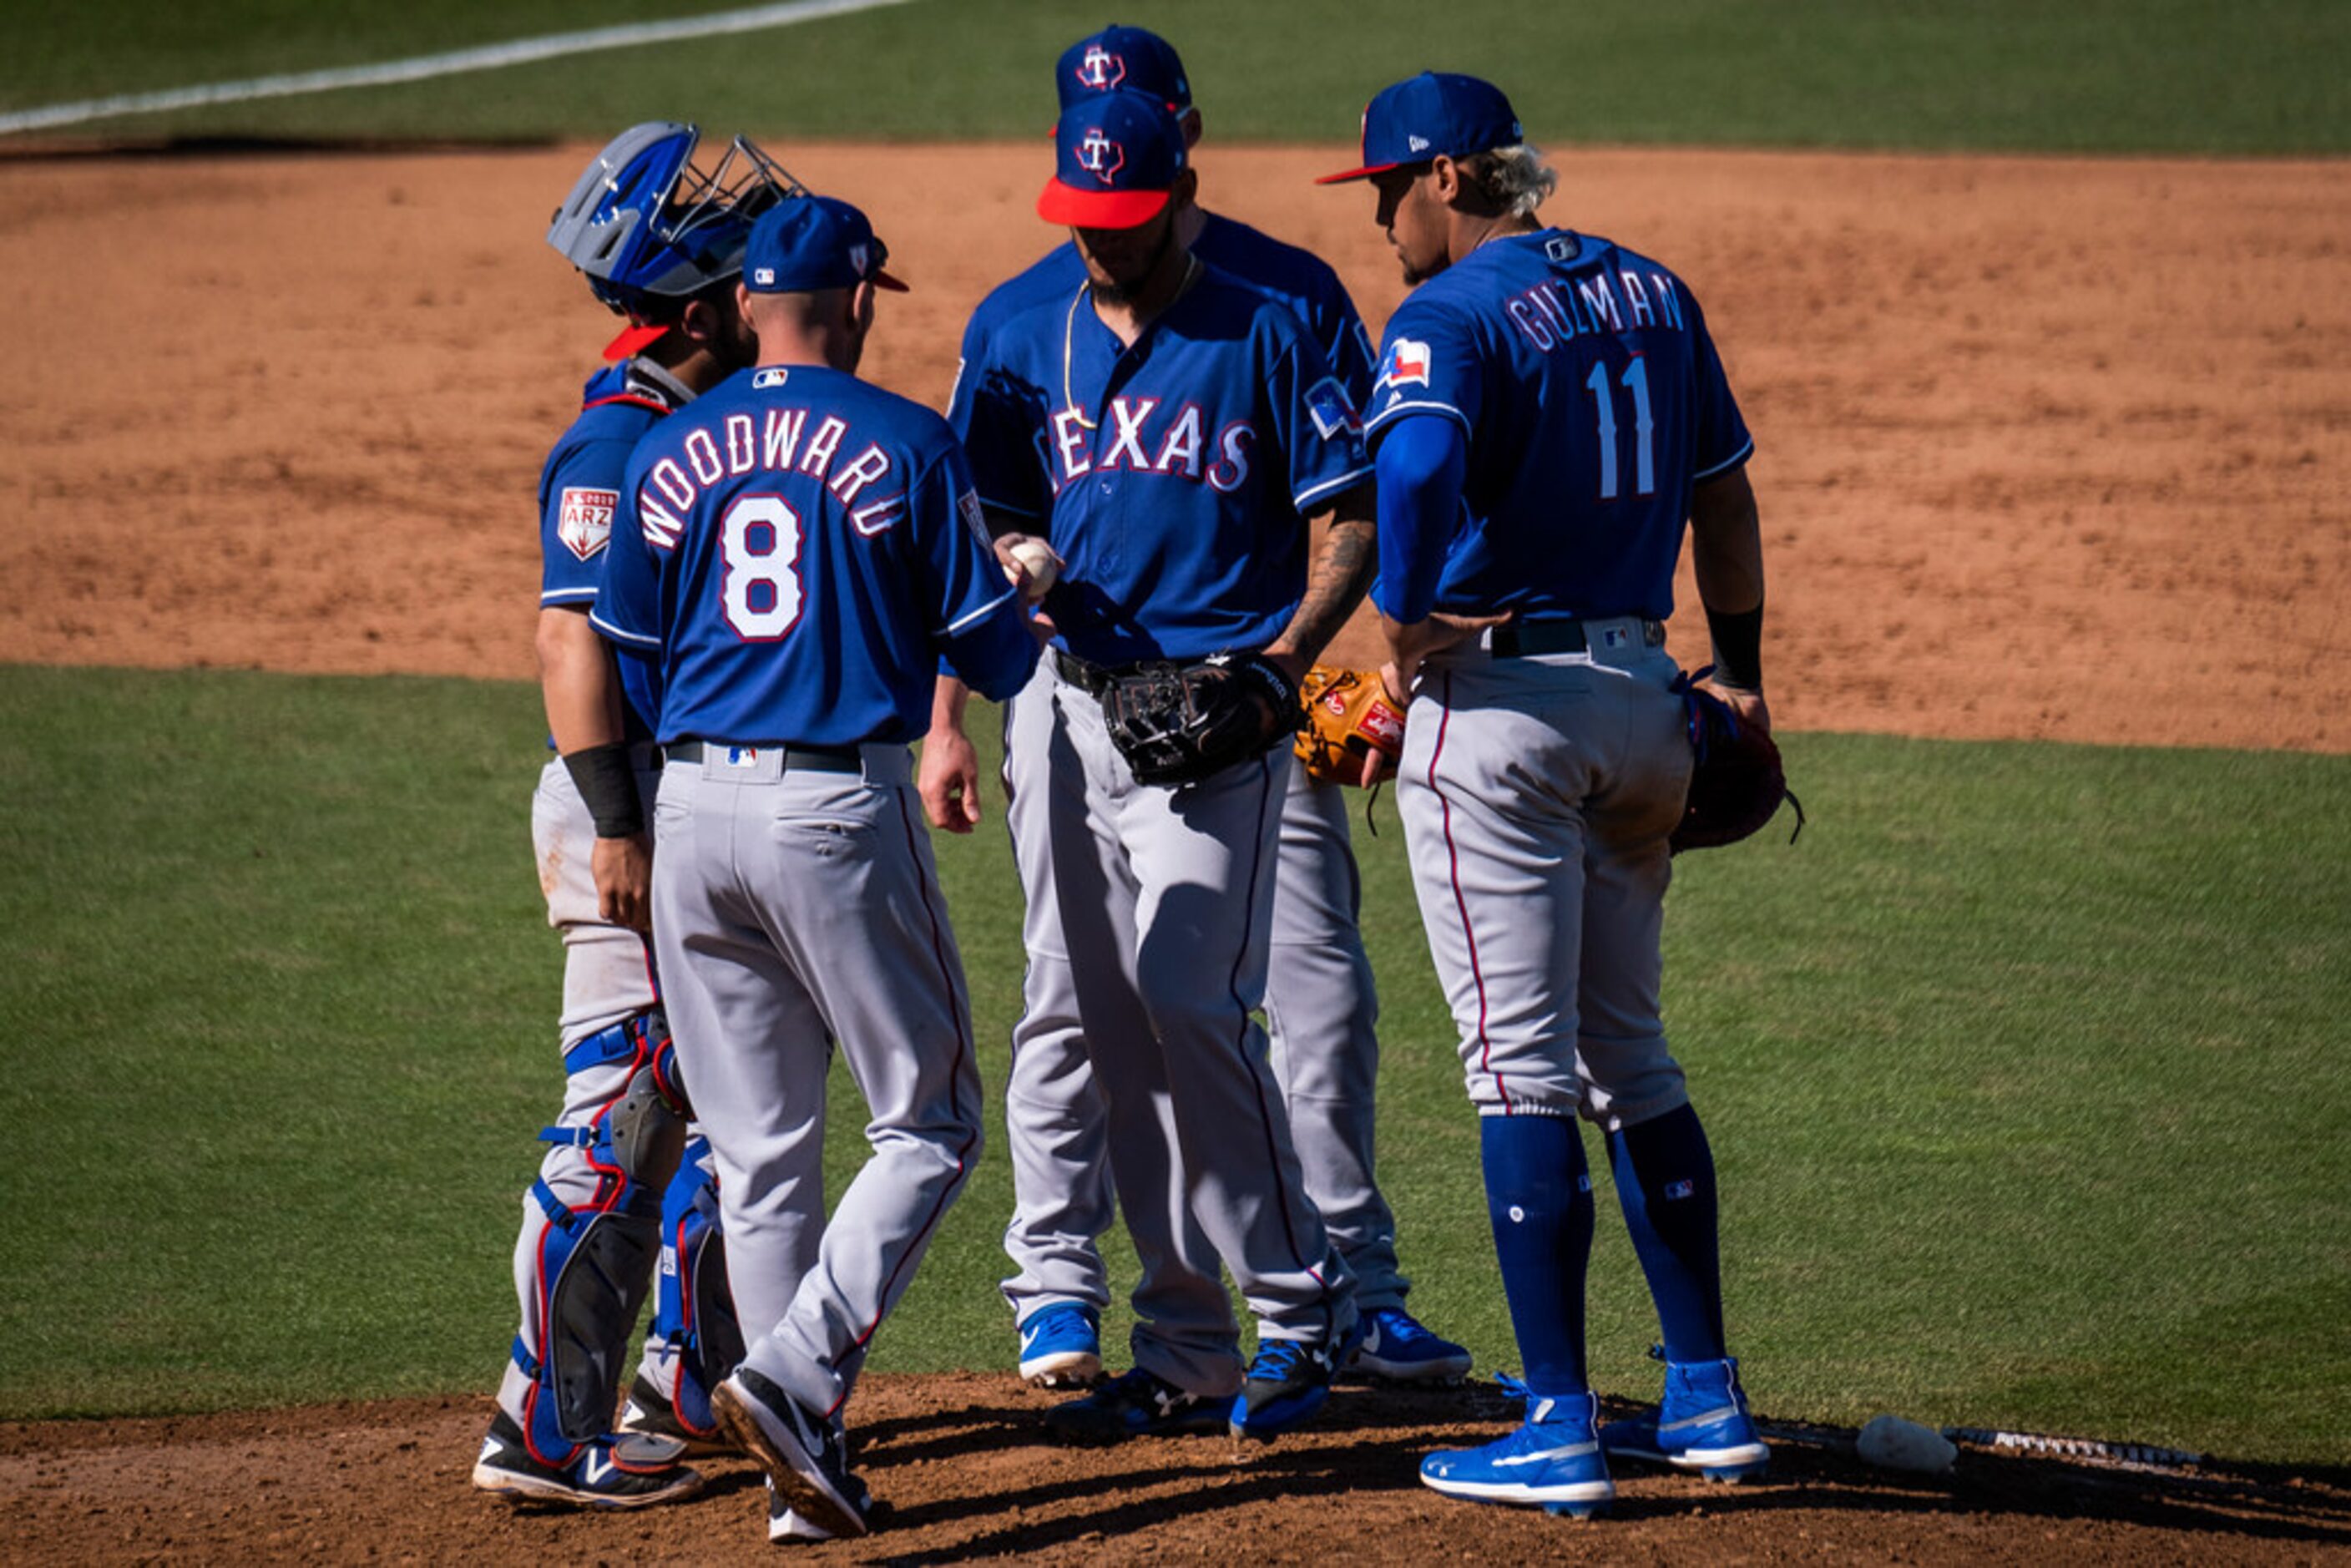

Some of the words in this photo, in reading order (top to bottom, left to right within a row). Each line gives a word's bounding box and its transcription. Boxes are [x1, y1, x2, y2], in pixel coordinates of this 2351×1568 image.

[1084, 52, 1110, 84] T
[1083, 138, 1110, 169] T
[1505, 269, 1684, 352] GUZMAN
[1033, 395, 1256, 499] EXAS
[1585, 352, 1656, 500] 11
[719, 493, 807, 643] 8
